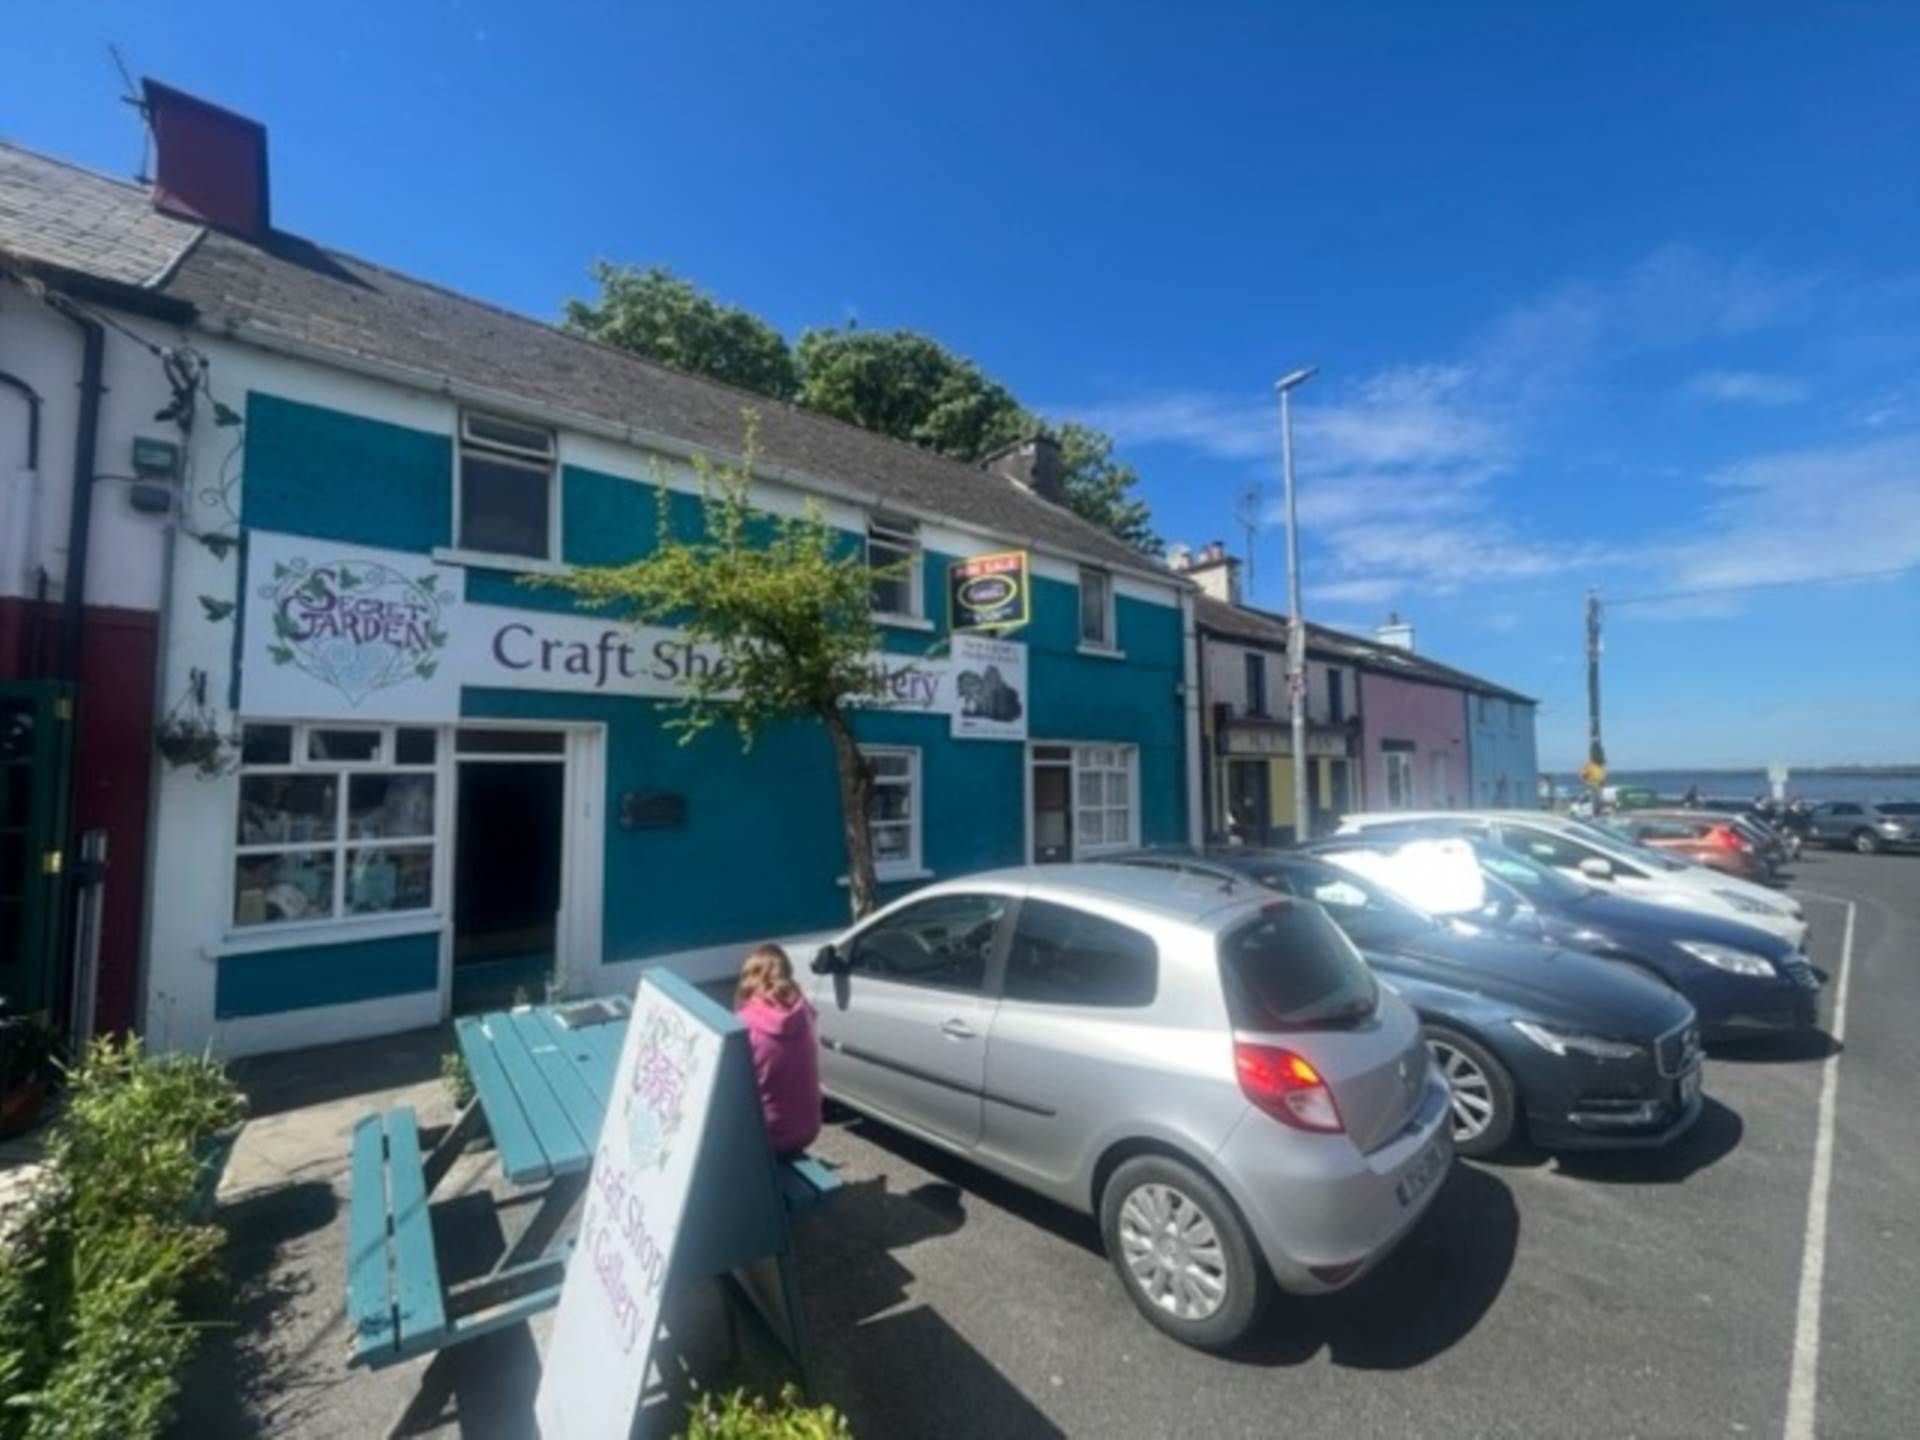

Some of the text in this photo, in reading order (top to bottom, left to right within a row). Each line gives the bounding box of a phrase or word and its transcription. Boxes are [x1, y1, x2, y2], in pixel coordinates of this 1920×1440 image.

[279, 594, 432, 651] GARDEN
[296, 568, 429, 624] SECRET
[492, 623, 637, 687] Craft
[622, 1193, 665, 1296] Shop
